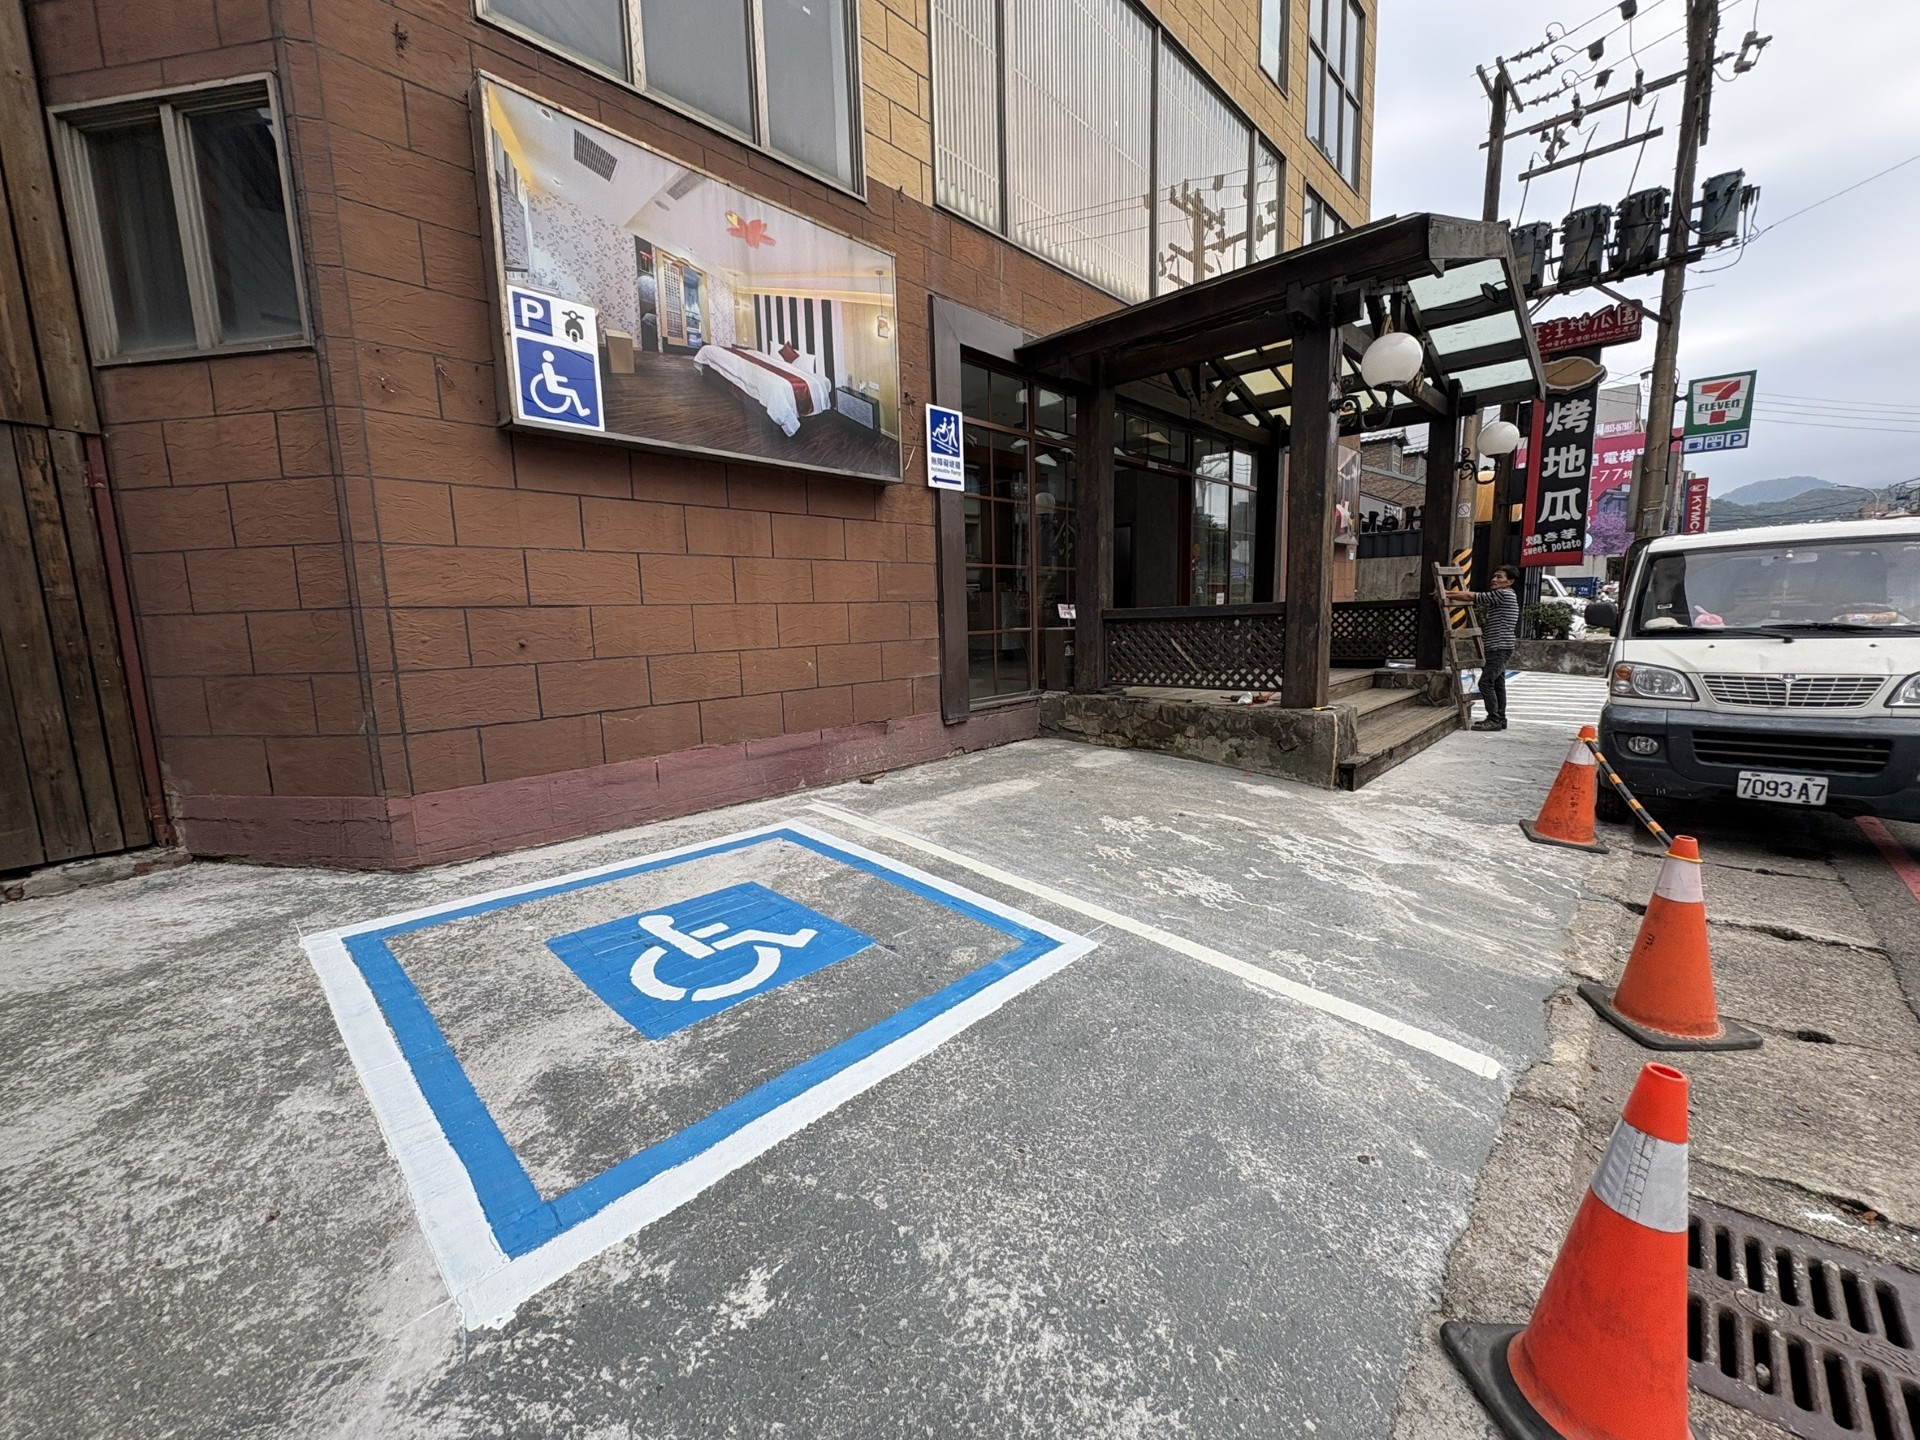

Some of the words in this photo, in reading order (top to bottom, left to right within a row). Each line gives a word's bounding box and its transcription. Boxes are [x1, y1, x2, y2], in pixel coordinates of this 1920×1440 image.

[520, 297, 544, 327] P
[1729, 433, 1742, 446] P
[1537, 398, 1593, 524] 烤地瓜
[1689, 495, 1703, 534] KYMC
[1523, 544, 1547, 556] sweet
[1551, 539, 1581, 552] potato
[1739, 777, 1826, 802] 7093-A7
